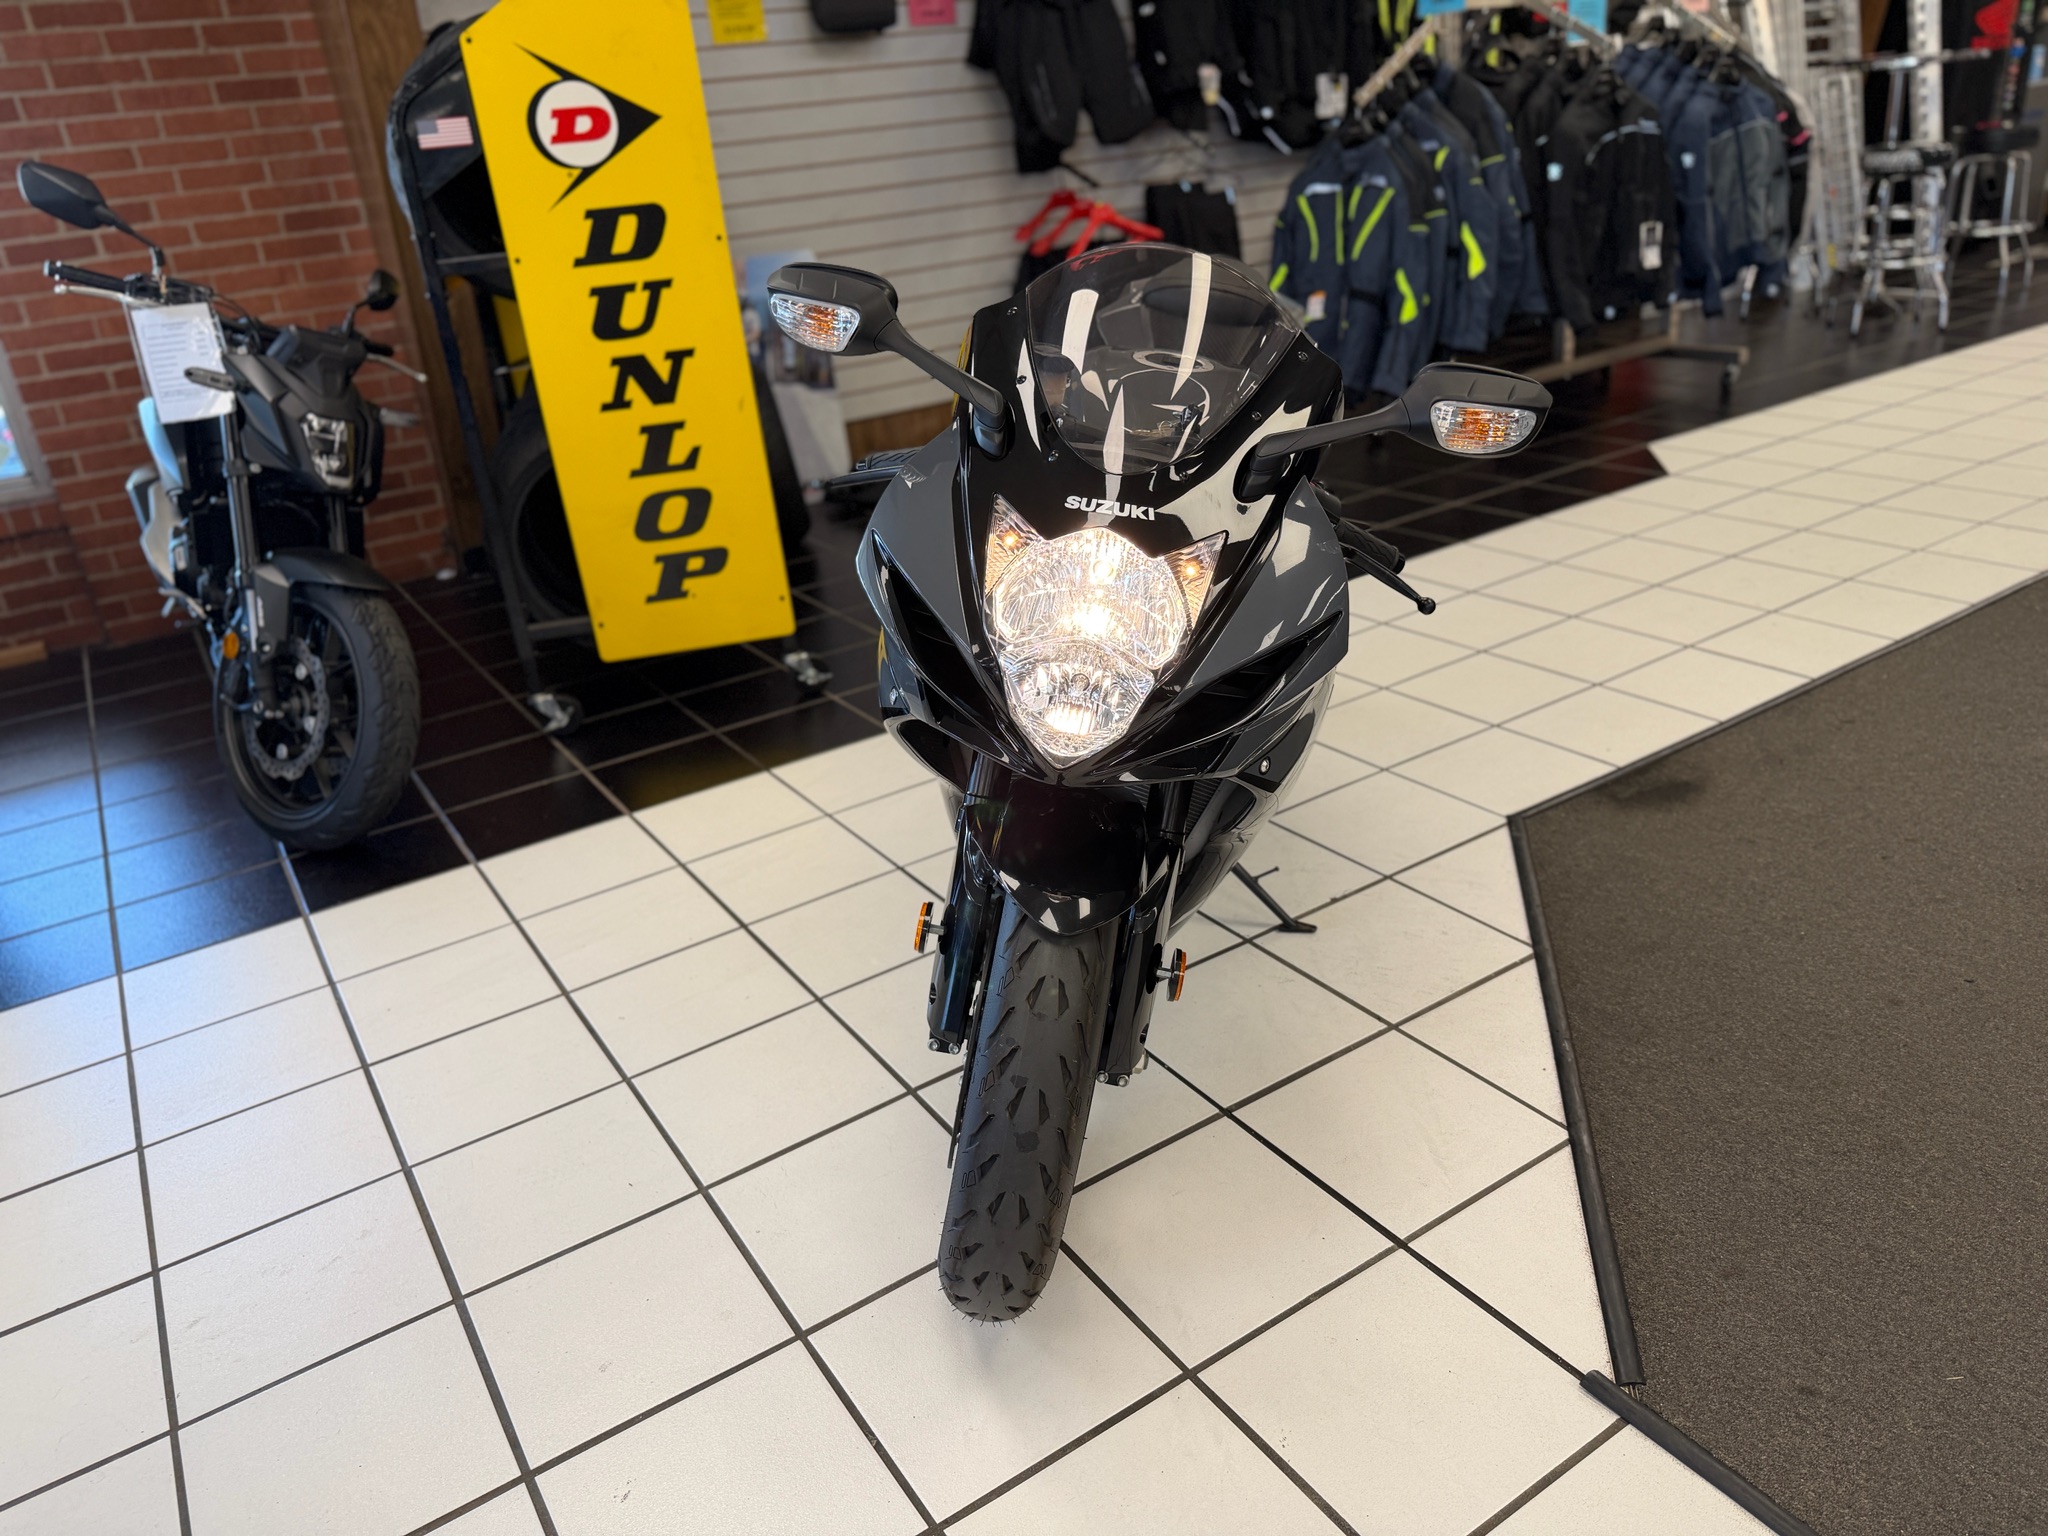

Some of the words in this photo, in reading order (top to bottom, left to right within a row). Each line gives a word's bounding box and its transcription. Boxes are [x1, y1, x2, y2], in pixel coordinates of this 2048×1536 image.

[550, 106, 611, 144] D
[573, 203, 729, 603] DUNLOP
[1064, 495, 1155, 521] SUZUKI
